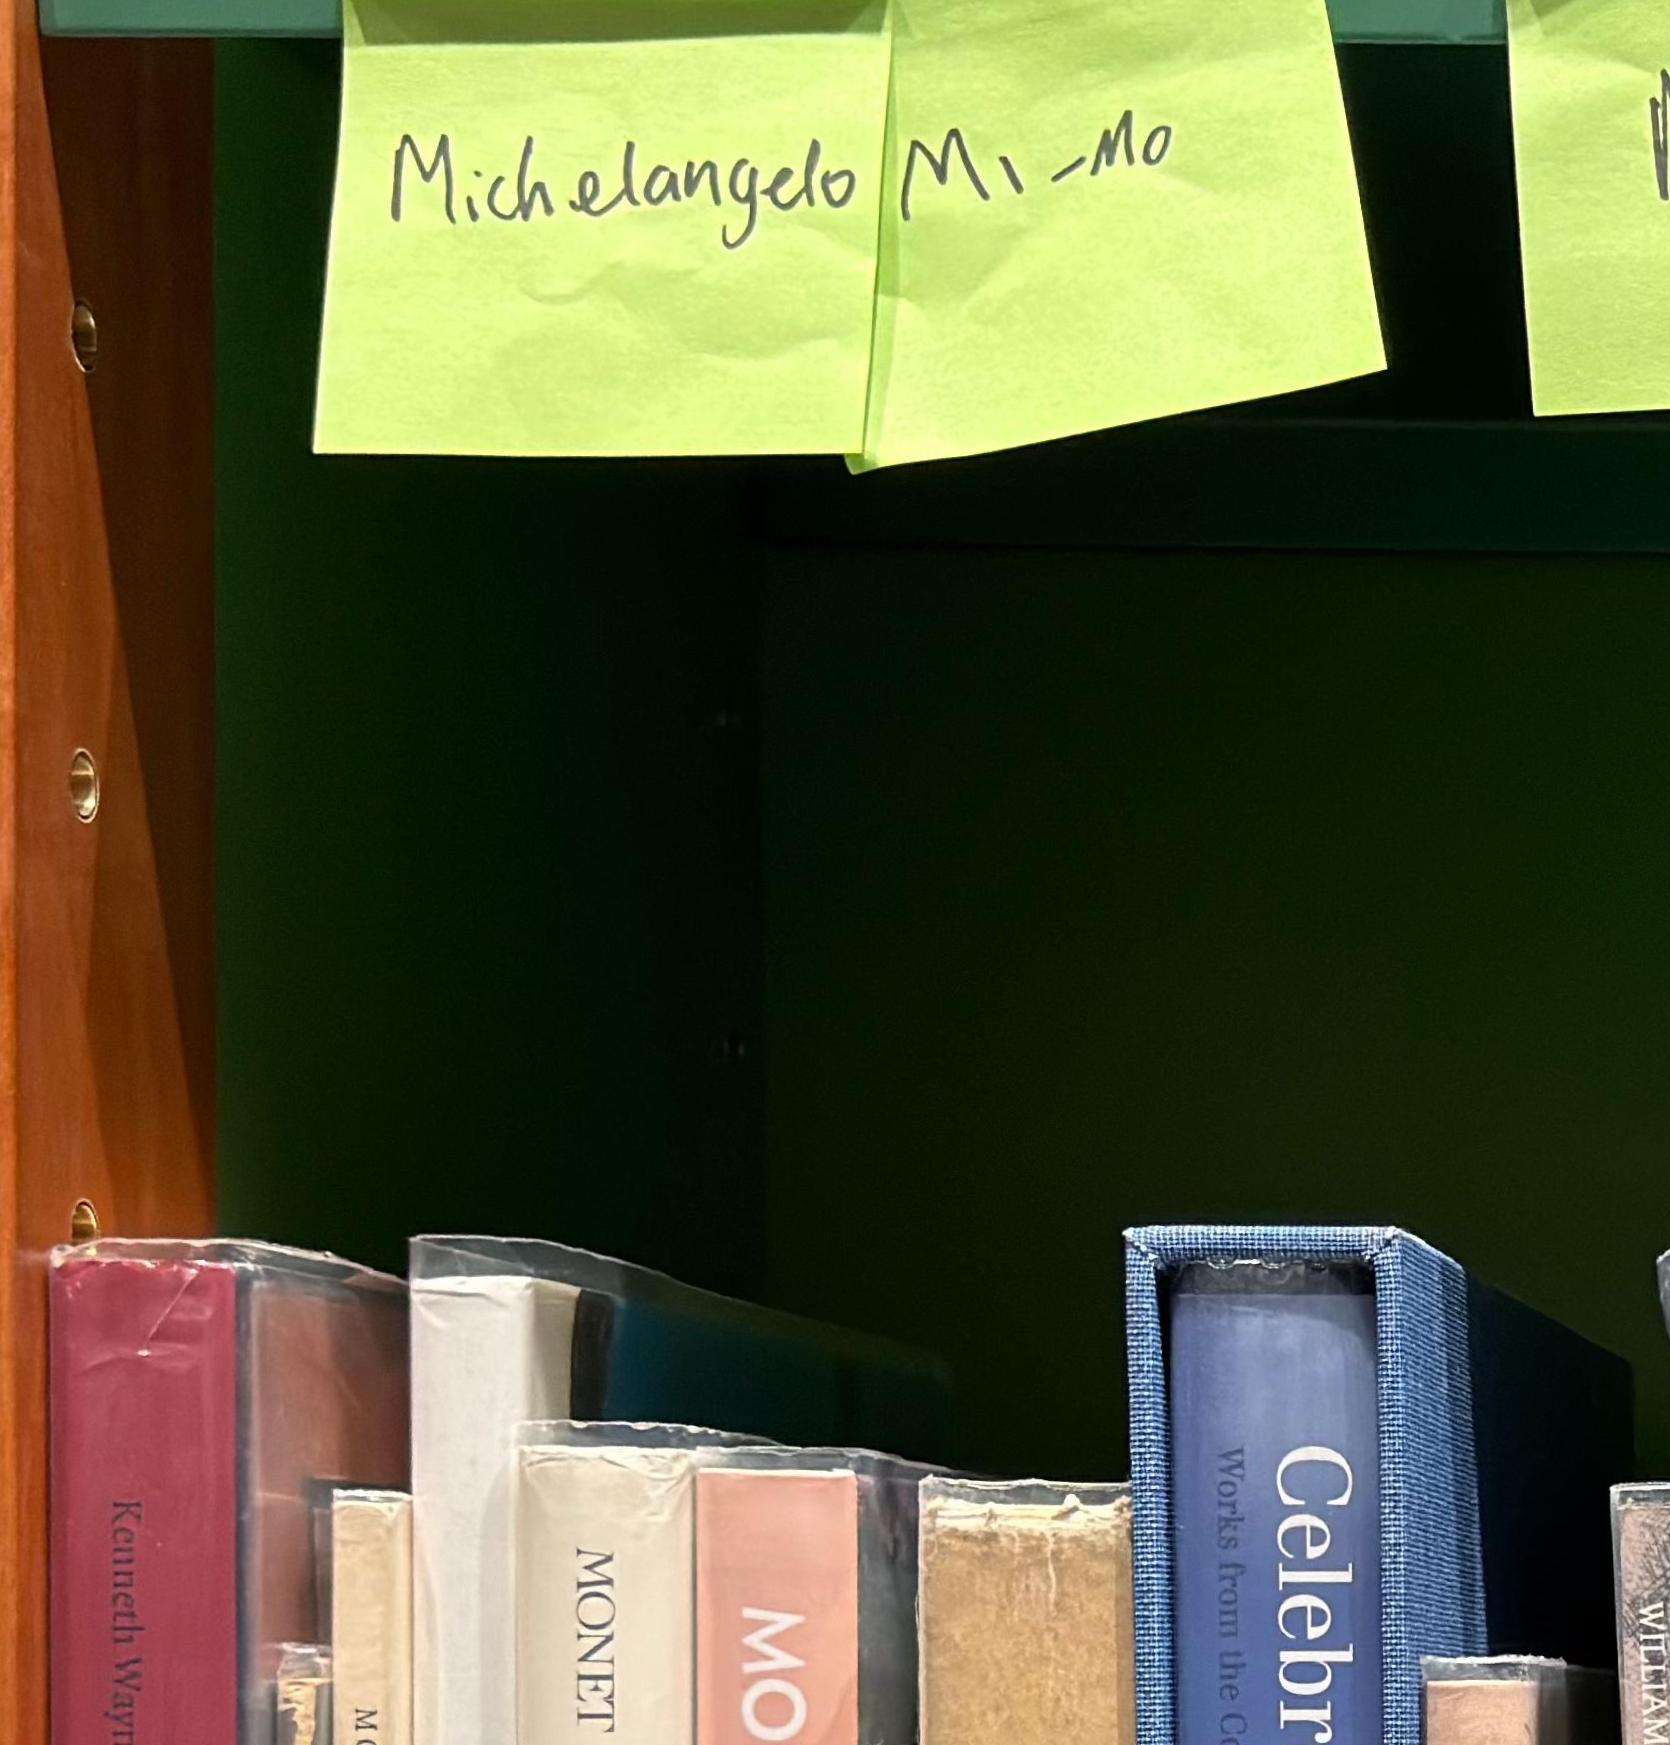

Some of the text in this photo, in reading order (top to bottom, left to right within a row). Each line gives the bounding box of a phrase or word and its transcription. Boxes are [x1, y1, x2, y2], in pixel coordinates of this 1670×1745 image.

[390, 132, 855, 249] Michelangelo
[1215, 1446, 1247, 1549] Works
[110, 1499, 147, 1645] Kenneth
[1217, 1560, 1247, 1639] from
[576, 1547, 616, 1733] MONET
[1218, 1650, 1247, 1700] the
[1637, 1600, 1668, 1745] WILLIAM
